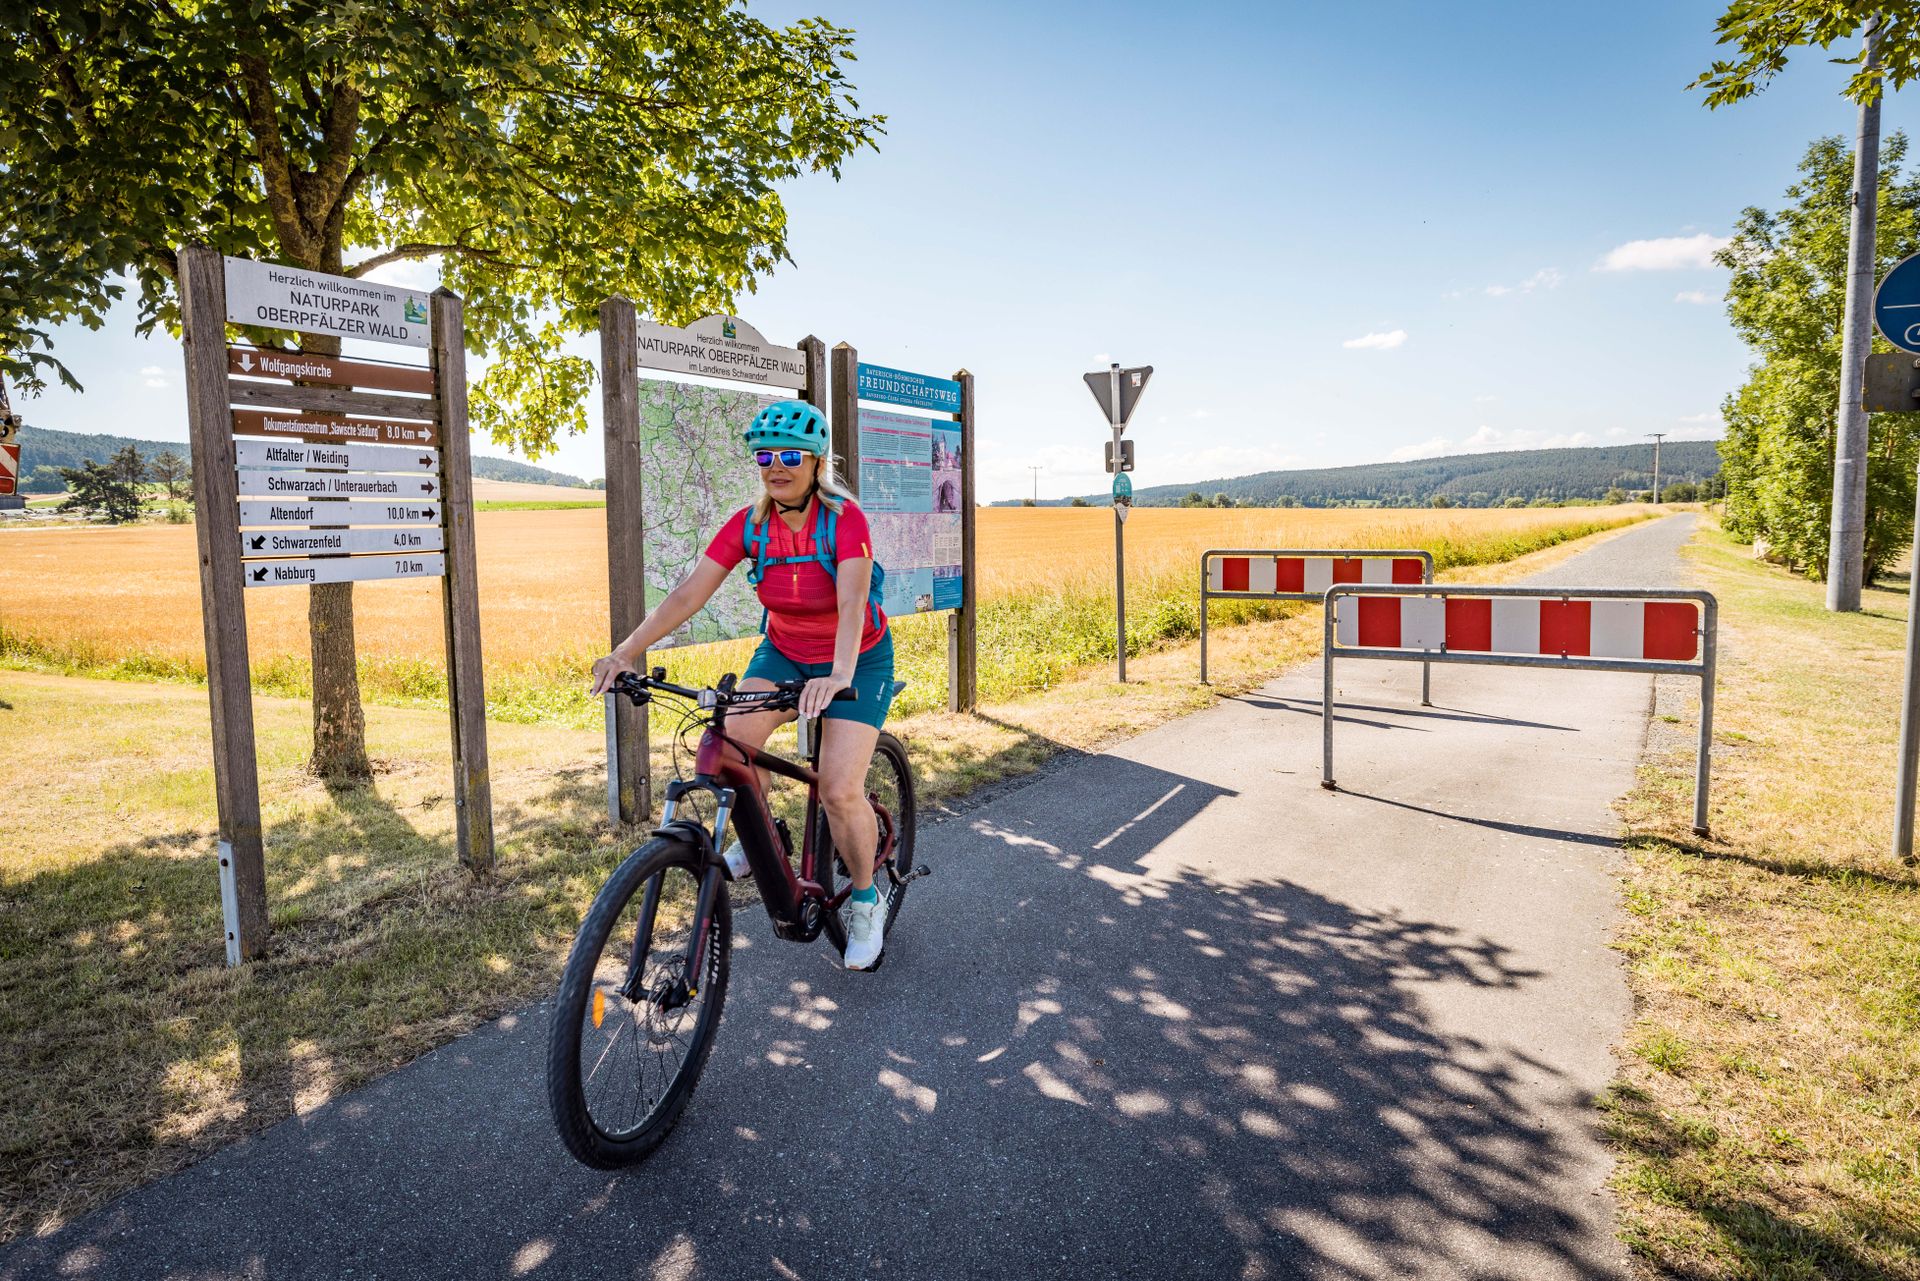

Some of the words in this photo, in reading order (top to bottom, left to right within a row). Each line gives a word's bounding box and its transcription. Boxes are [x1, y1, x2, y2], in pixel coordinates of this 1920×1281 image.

[269, 271, 315, 289] Herzlich
[317, 280, 381, 300] willkommen
[383, 291, 396, 302] im
[290, 291, 380, 318] NATURPARK
[257, 305, 365, 334] OBERPFÄLZER
[368, 322, 408, 340] WALD
[696, 333, 723, 346] Herzlich
[724, 340, 760, 353] willkommen
[637, 336, 706, 360] NATURPARK
[708, 348, 779, 372] OBERPFÄLZER
[780, 362, 805, 376] WALD
[259, 357, 332, 379] Wolfgangskirche
[688, 361, 697, 371] im
[698, 362, 731, 377] Landkreis
[732, 367, 768, 381] Schwandorf
[859, 375, 957, 402] FREUNDSCHAFTSWEG
[263, 416, 329, 435] Dokumentationszentrum
[401, 428, 415, 440] km
[266, 447, 304, 463] Altfalter
[306, 449, 310, 463] /
[312, 449, 349, 467] Weiding
[268, 477, 326, 492] Schwarzach
[328, 478, 332, 492] /
[334, 479, 398, 493] Unterauerbach
[270, 506, 314, 520] Altendorf
[387, 507, 405, 520] 10,0
[406, 507, 419, 520] km
[272, 535, 341, 550] Schwarzenfeld
[393, 533, 407, 546] 4,0
[408, 533, 421, 546] km
[274, 567, 316, 582] Nabburg
[395, 561, 408, 574] 7,0
[409, 560, 423, 573] km
